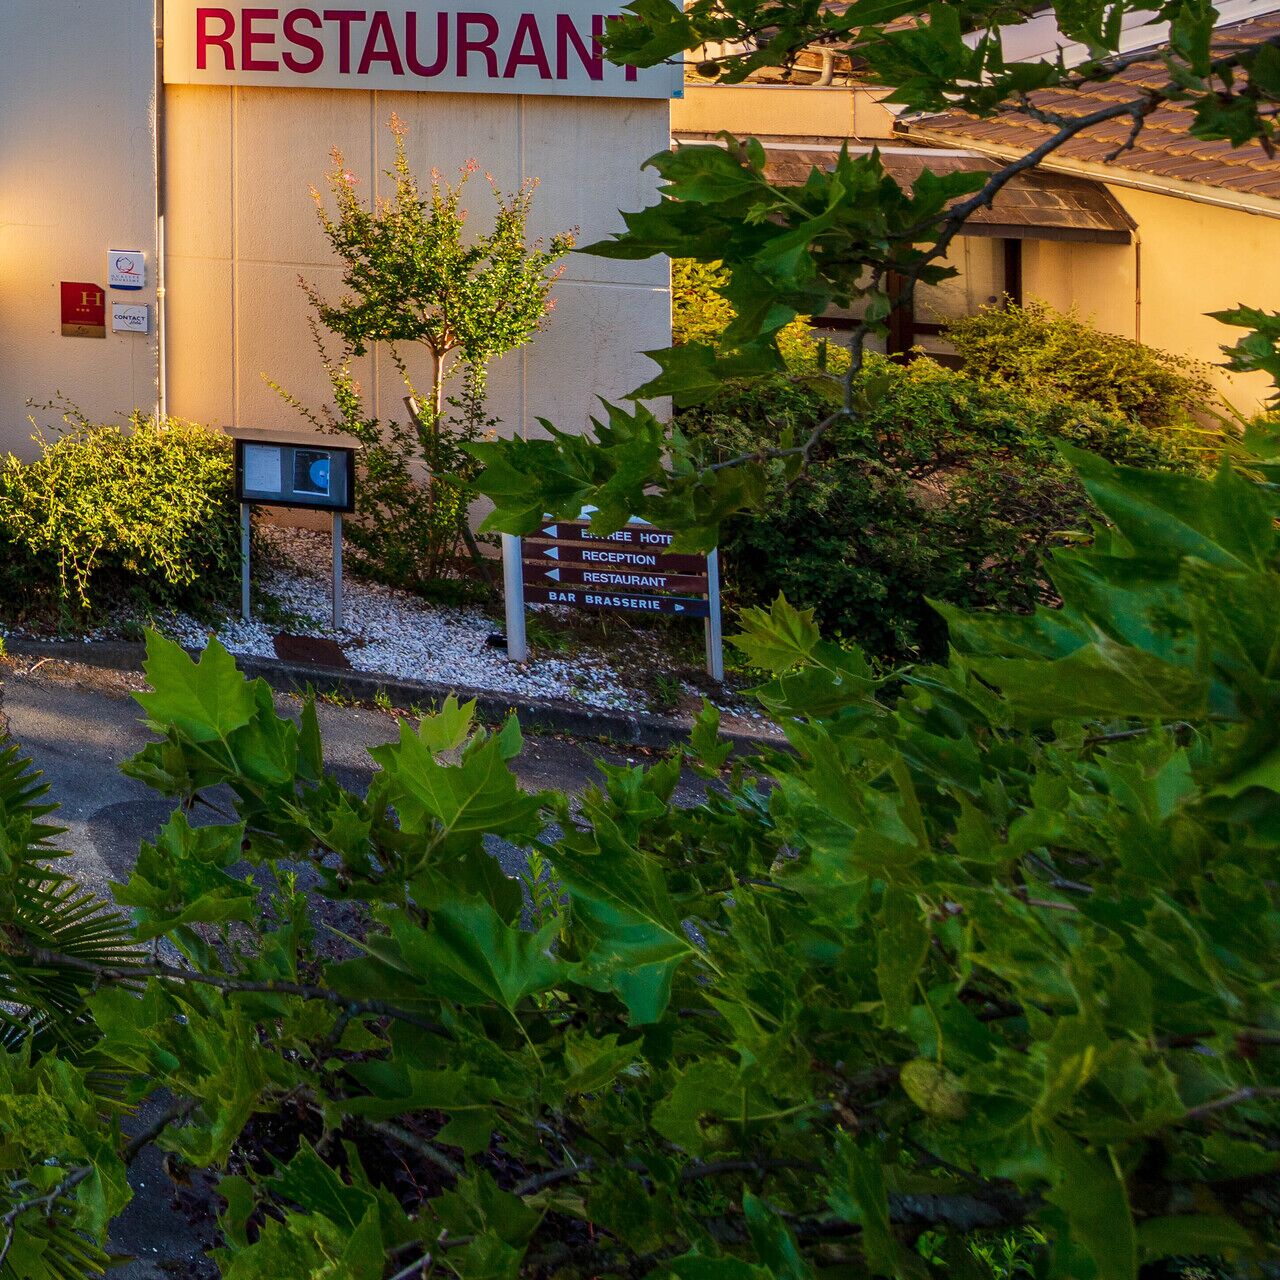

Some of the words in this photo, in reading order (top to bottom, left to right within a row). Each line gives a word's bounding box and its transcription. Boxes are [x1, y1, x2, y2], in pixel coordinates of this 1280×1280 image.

[114, 314, 146, 322] CONTACT
[640, 533, 673, 545] HOTE
[582, 550, 656, 566] RECEPTION
[583, 572, 667, 587] RESTAURANT
[549, 591, 576, 603] BAR
[585, 595, 661, 610] BRASSERIE
